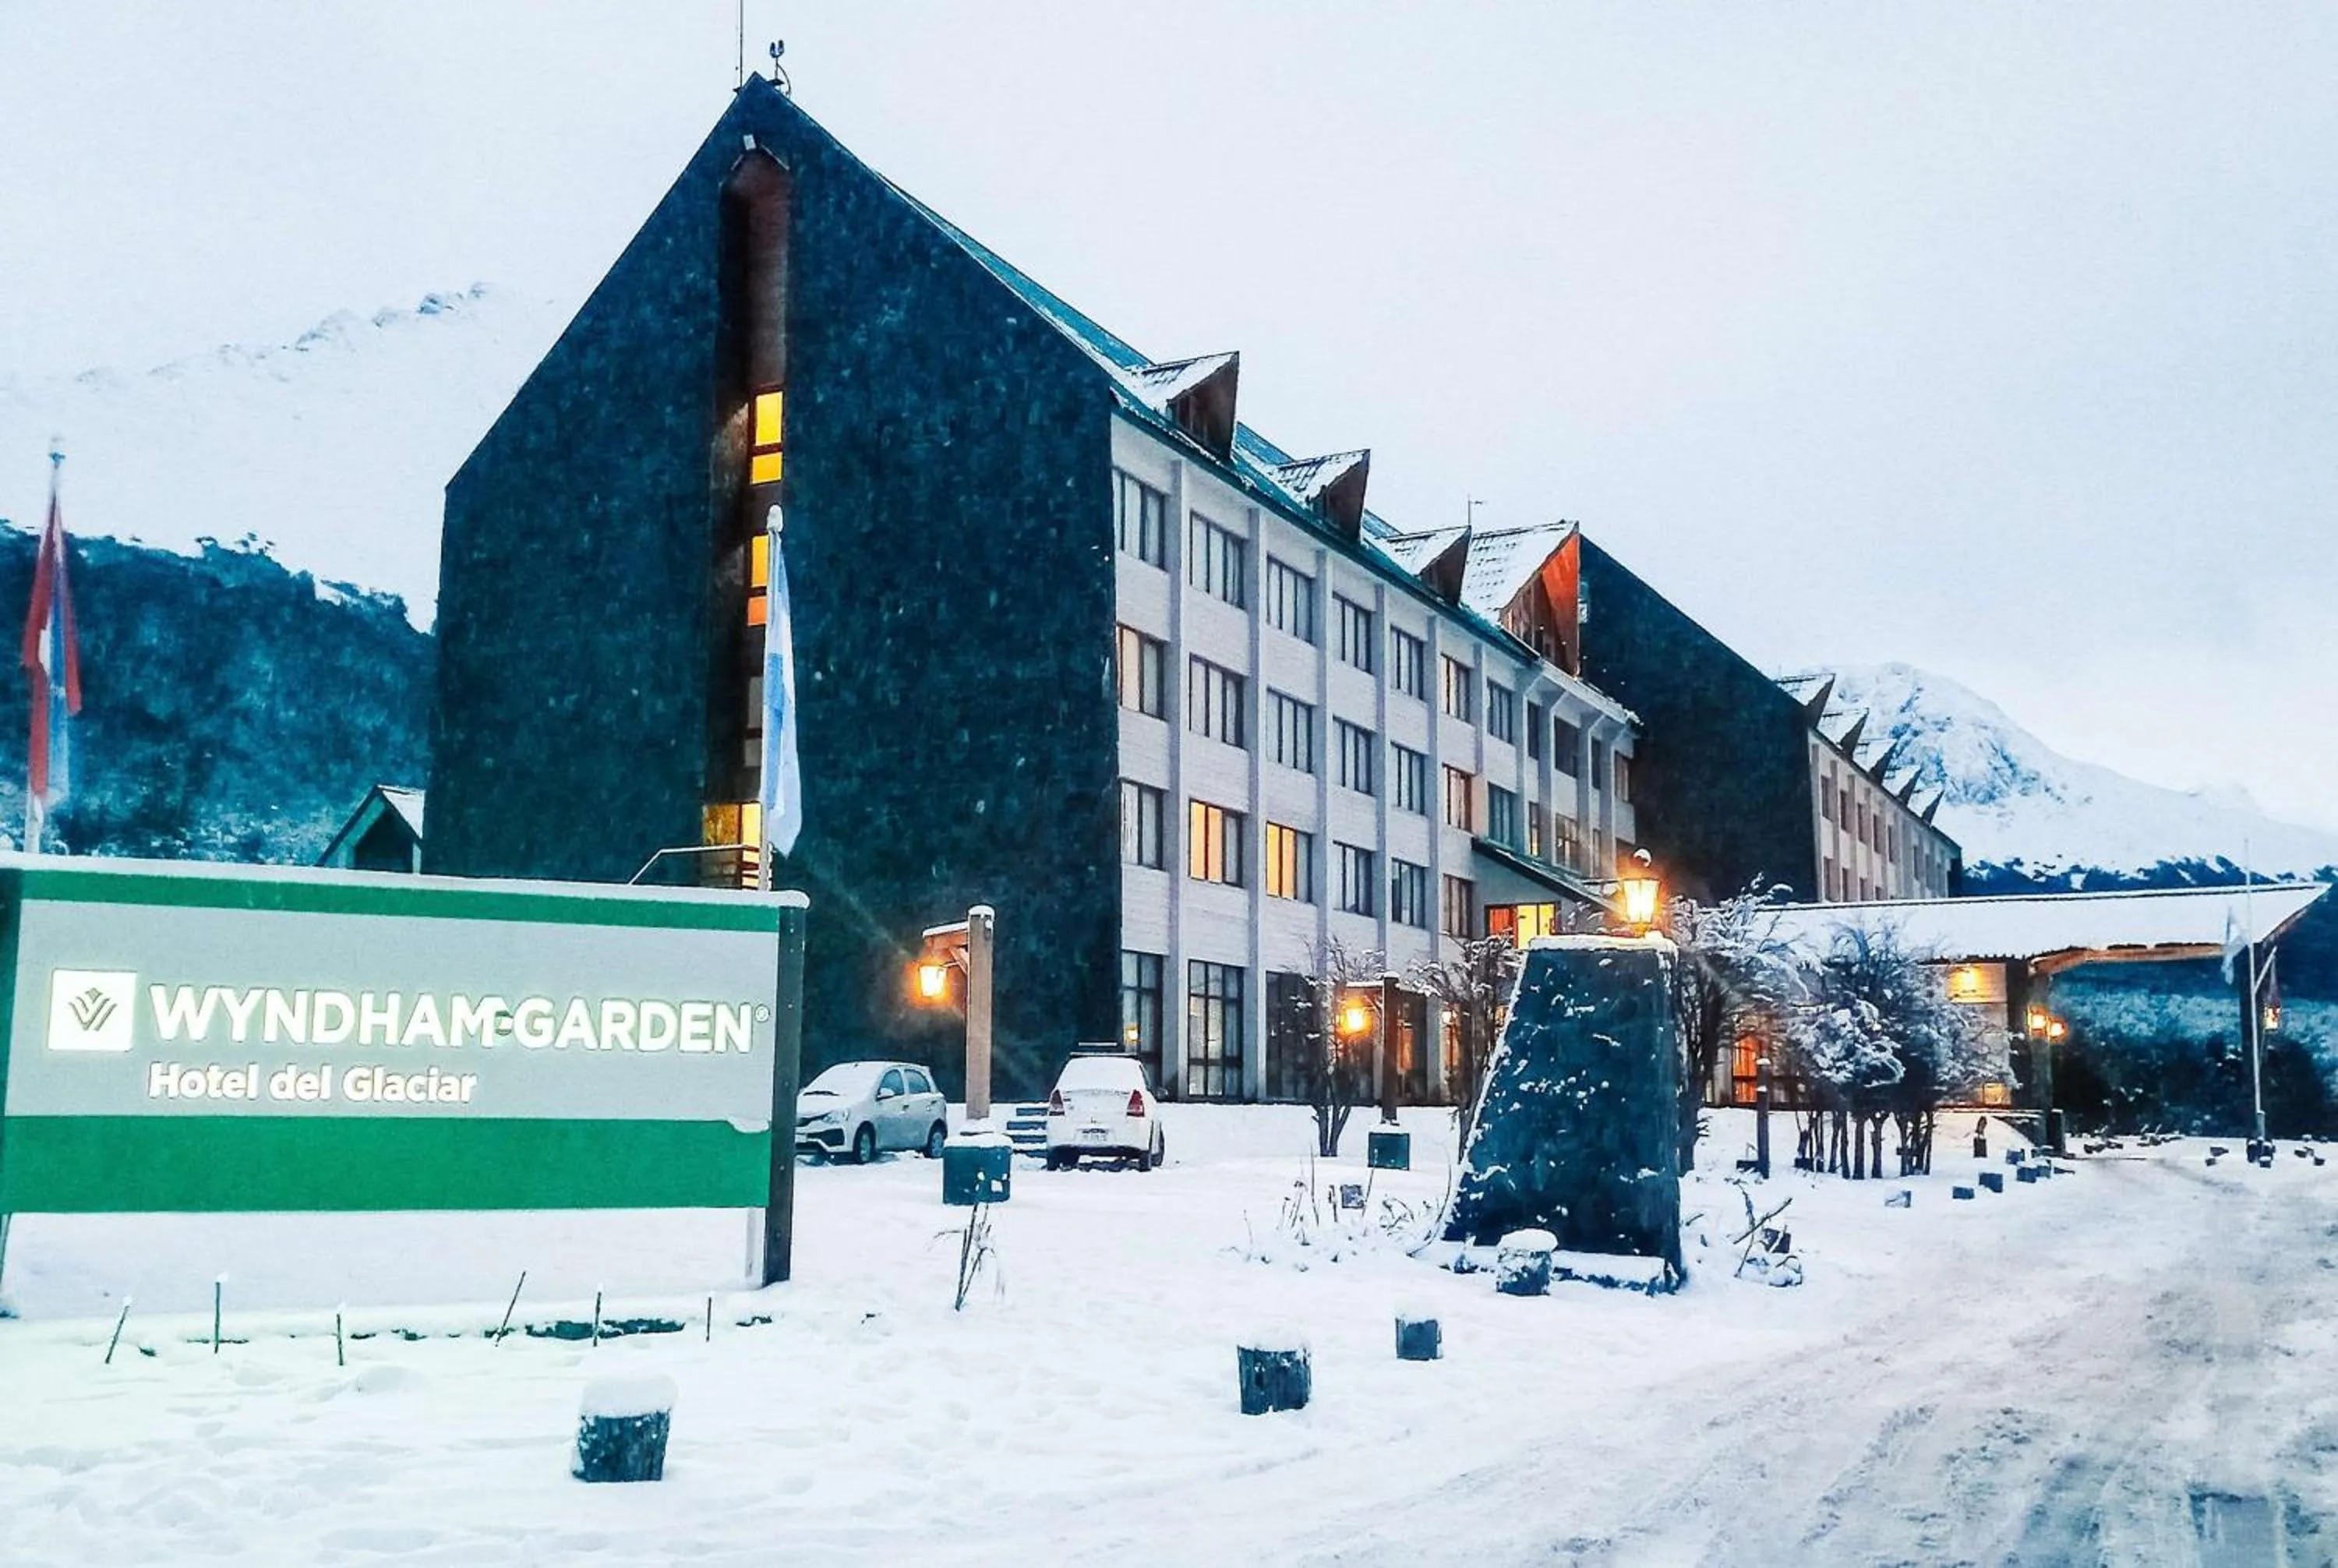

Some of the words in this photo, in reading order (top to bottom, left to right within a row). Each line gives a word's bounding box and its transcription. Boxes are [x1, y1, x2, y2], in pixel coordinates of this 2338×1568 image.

[149, 984, 497, 1048] WYNDHAM
[149, 1061, 259, 1100] Hotel
[269, 1062, 333, 1101] del
[341, 1065, 478, 1104] Glaciar
